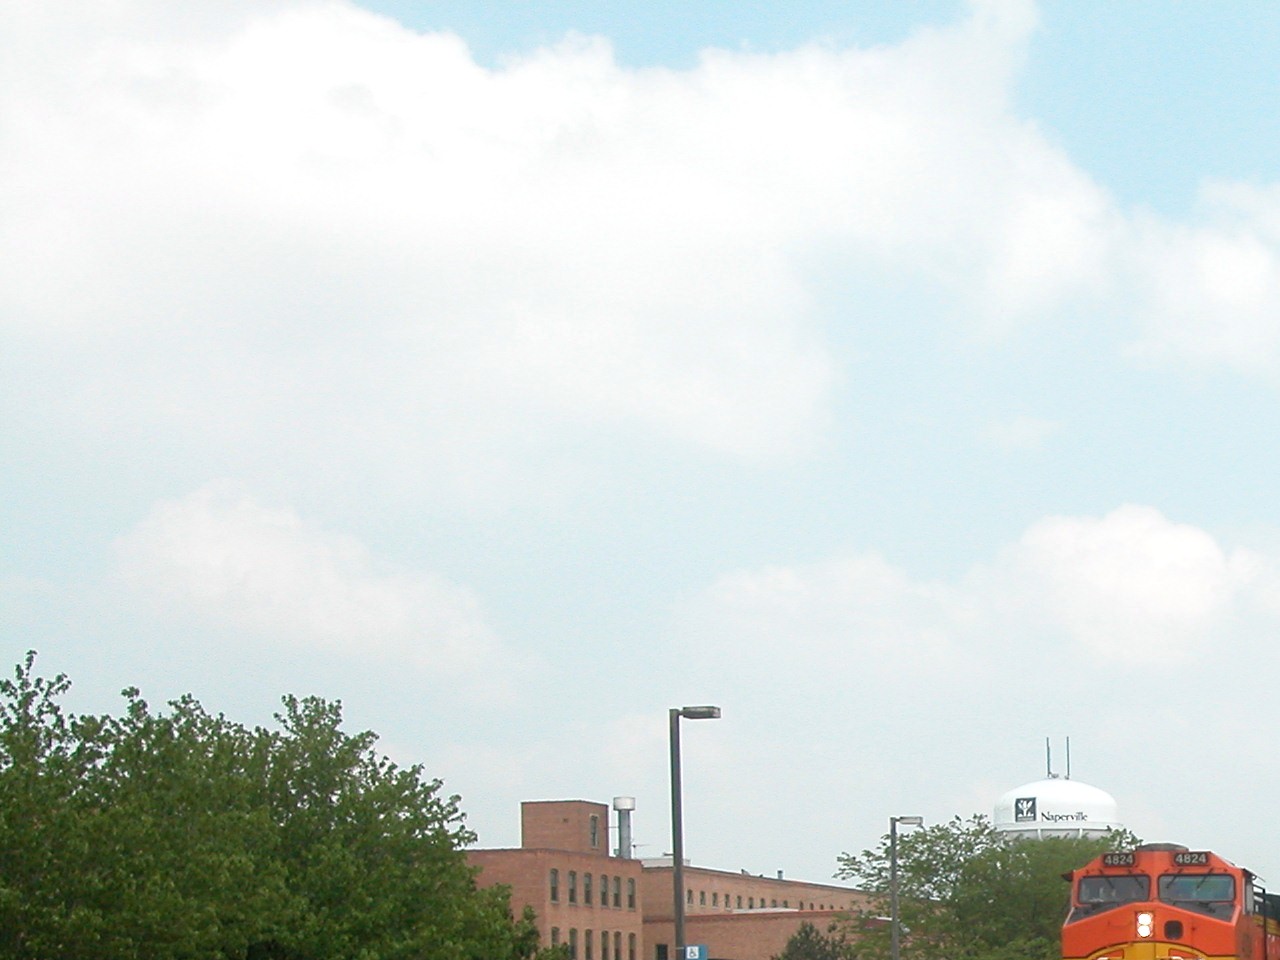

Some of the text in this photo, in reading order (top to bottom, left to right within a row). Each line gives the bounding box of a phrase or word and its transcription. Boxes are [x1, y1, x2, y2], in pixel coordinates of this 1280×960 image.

[1041, 812, 1088, 823] Naperville
[1105, 855, 1133, 865] 4824
[1175, 853, 1206, 864] 4824
